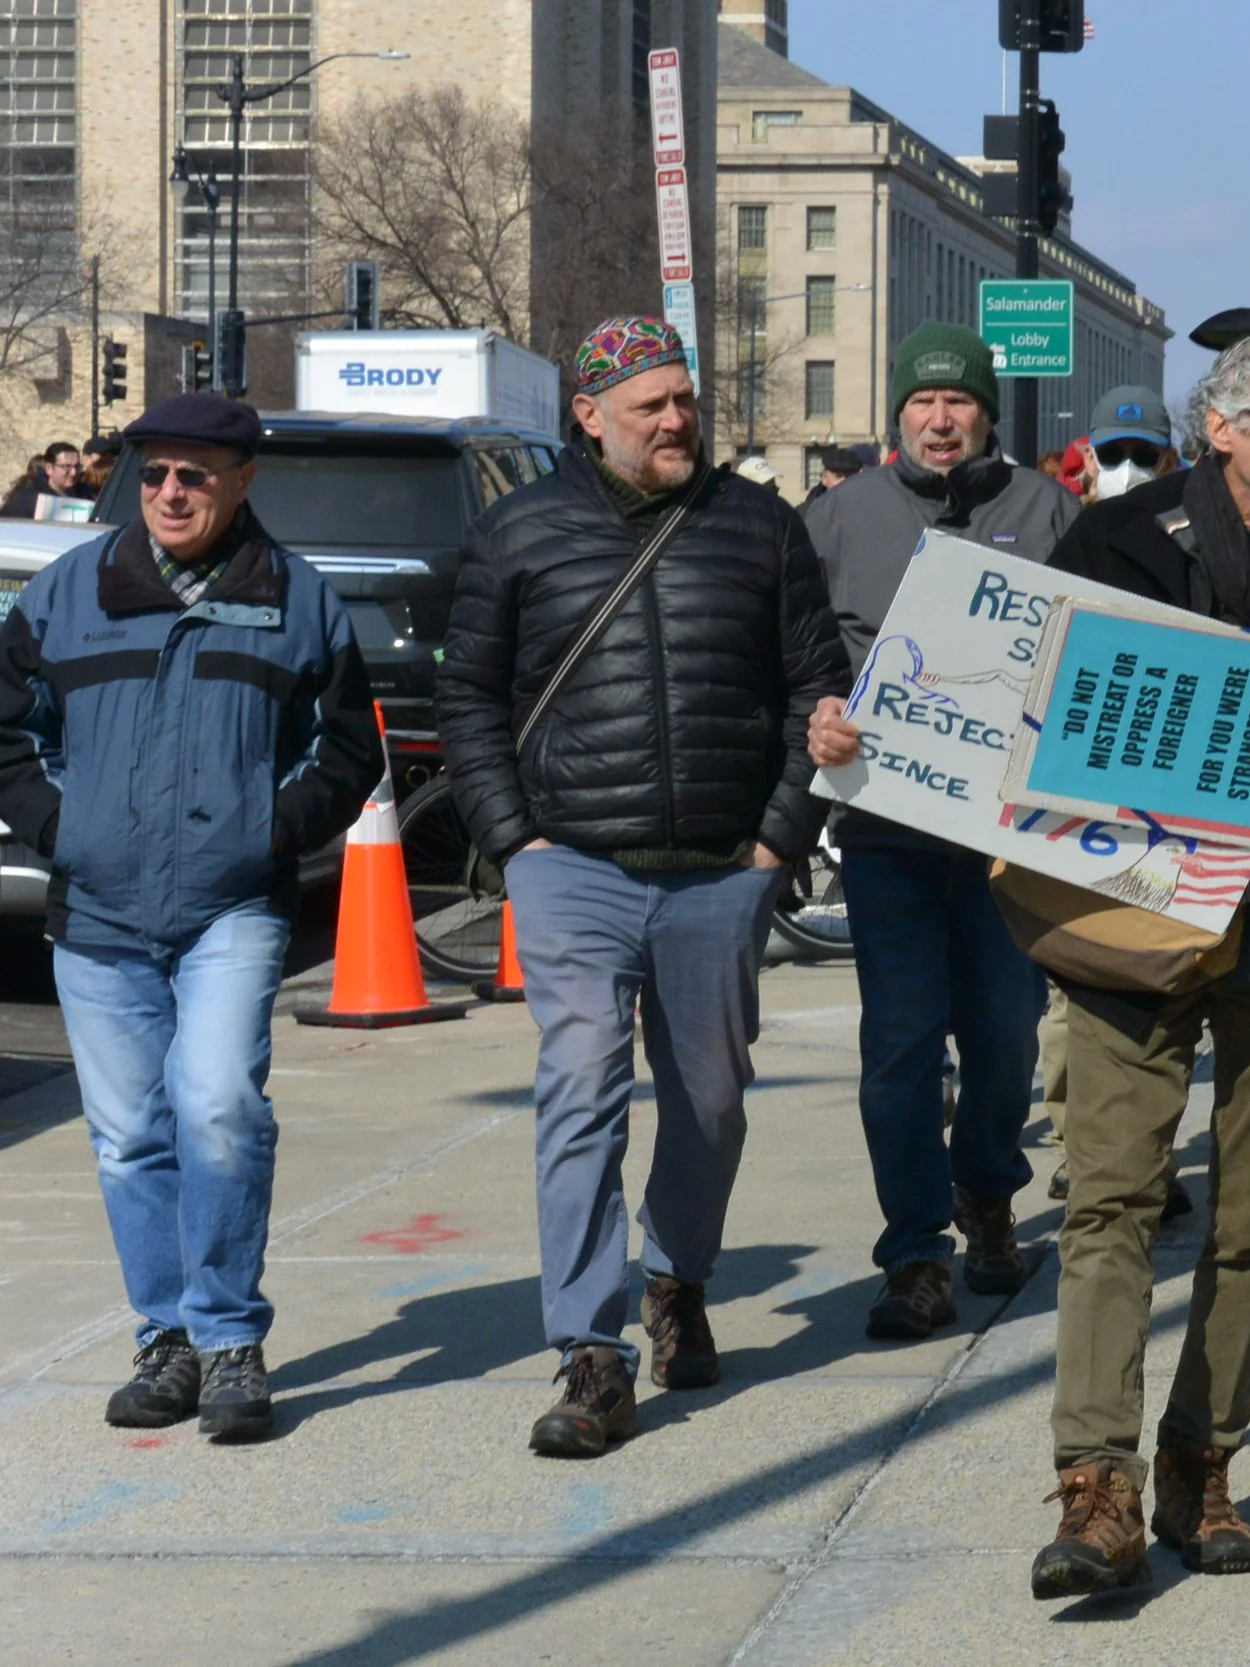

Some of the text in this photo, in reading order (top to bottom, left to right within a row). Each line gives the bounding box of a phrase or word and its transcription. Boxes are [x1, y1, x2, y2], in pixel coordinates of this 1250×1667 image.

[985, 296, 1066, 311] Salamander
[338, 362, 443, 386] BRODY
[1010, 332, 1050, 348] Lobby
[1010, 353, 1066, 367] Entrance
[872, 681, 1015, 751] REJEC
[1070, 667, 1100, 705] NOT
[1086, 652, 1138, 770] MISTREAT OR
[1121, 667, 1168, 767] OPPRESS A
[1152, 673, 1199, 771] FOREIGNER
[1196, 666, 1250, 793] FOR YOU WERE
[857, 730, 969, 800] SINCE
